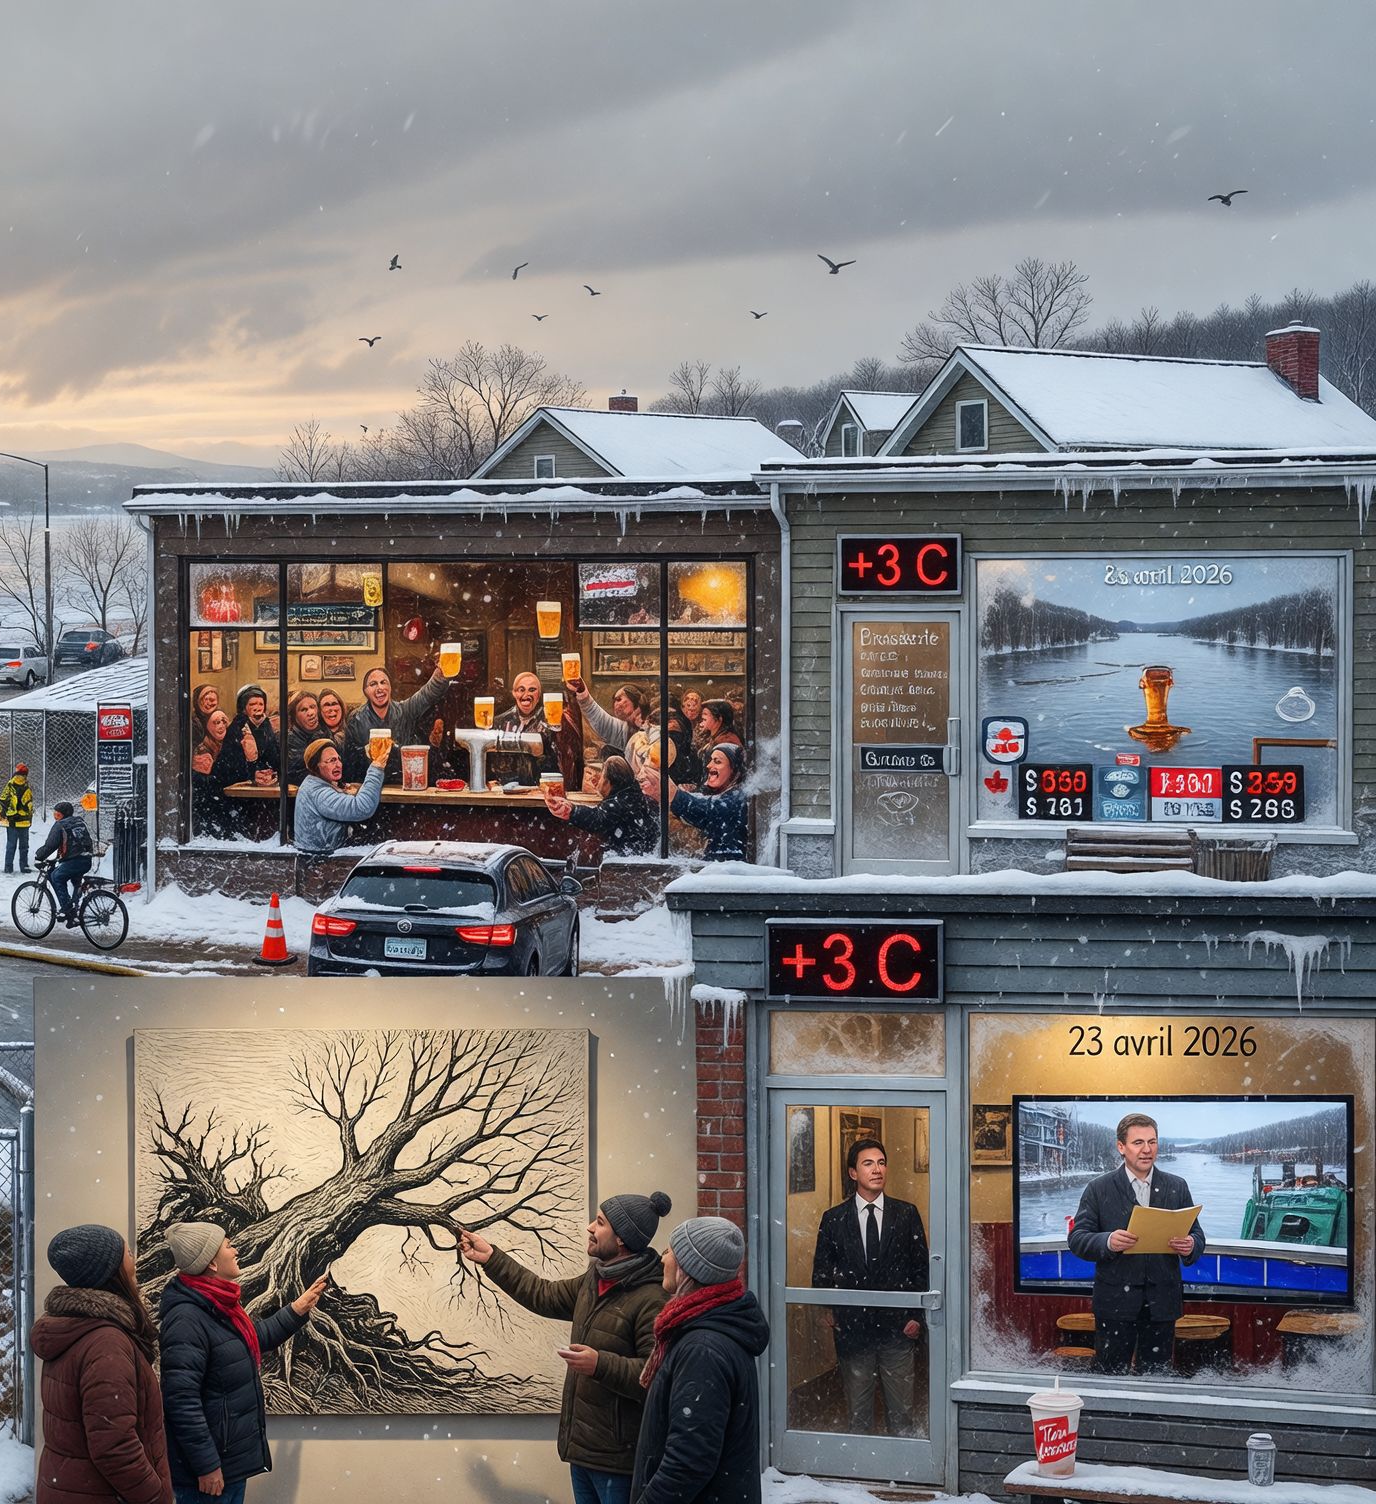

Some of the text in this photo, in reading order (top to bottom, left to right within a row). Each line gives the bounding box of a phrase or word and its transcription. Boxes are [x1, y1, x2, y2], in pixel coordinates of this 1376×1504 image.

[848, 543, 948, 586] +3 C
[1180, 563, 1233, 585] 2026
[782, 932, 922, 992] +3 C
[1068, 1024, 1257, 1057] 23 avril 2026
